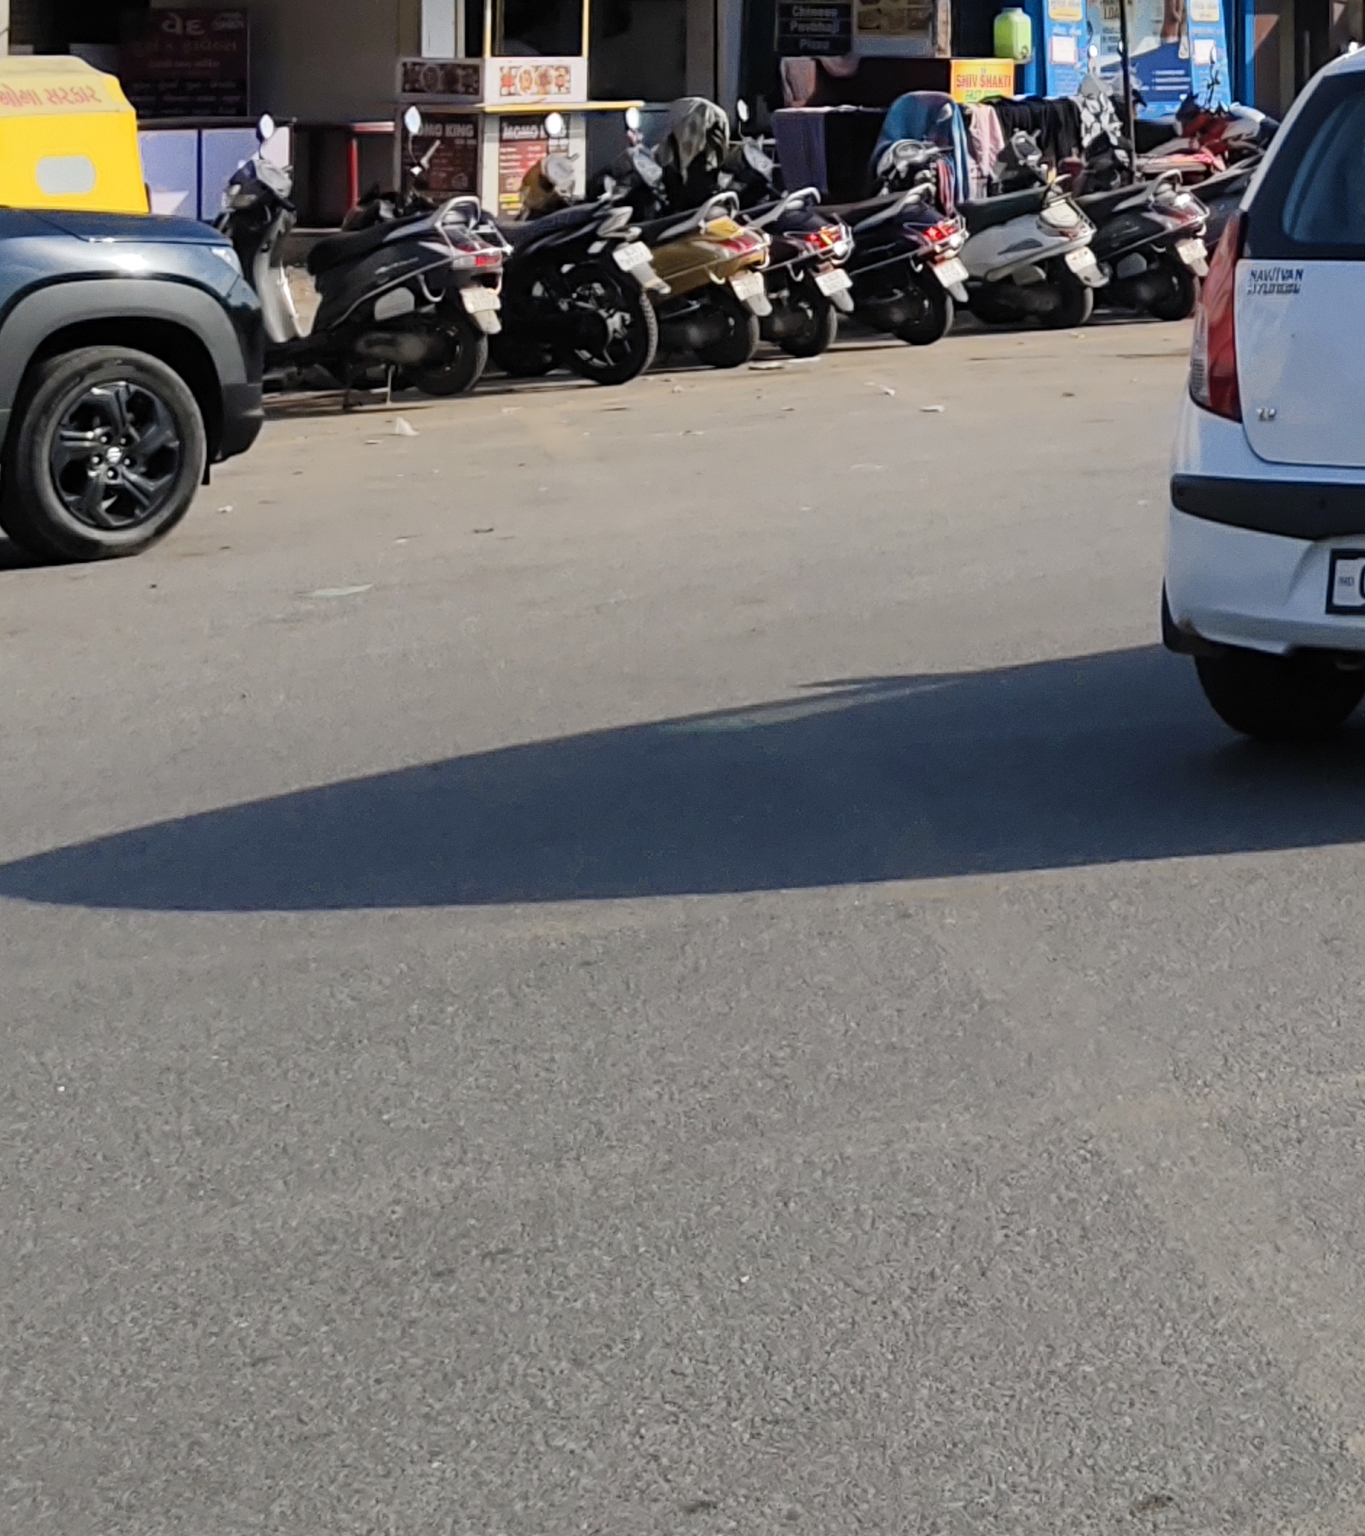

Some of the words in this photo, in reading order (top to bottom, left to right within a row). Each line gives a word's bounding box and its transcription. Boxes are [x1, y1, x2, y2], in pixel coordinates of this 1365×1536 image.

[956, 75, 977, 88] SHIV
[979, 73, 1011, 88] SHAKTI
[445, 124, 474, 138] KING
[502, 125, 539, 140] MOMO
[1250, 267, 1304, 283] NAVJIVAN
